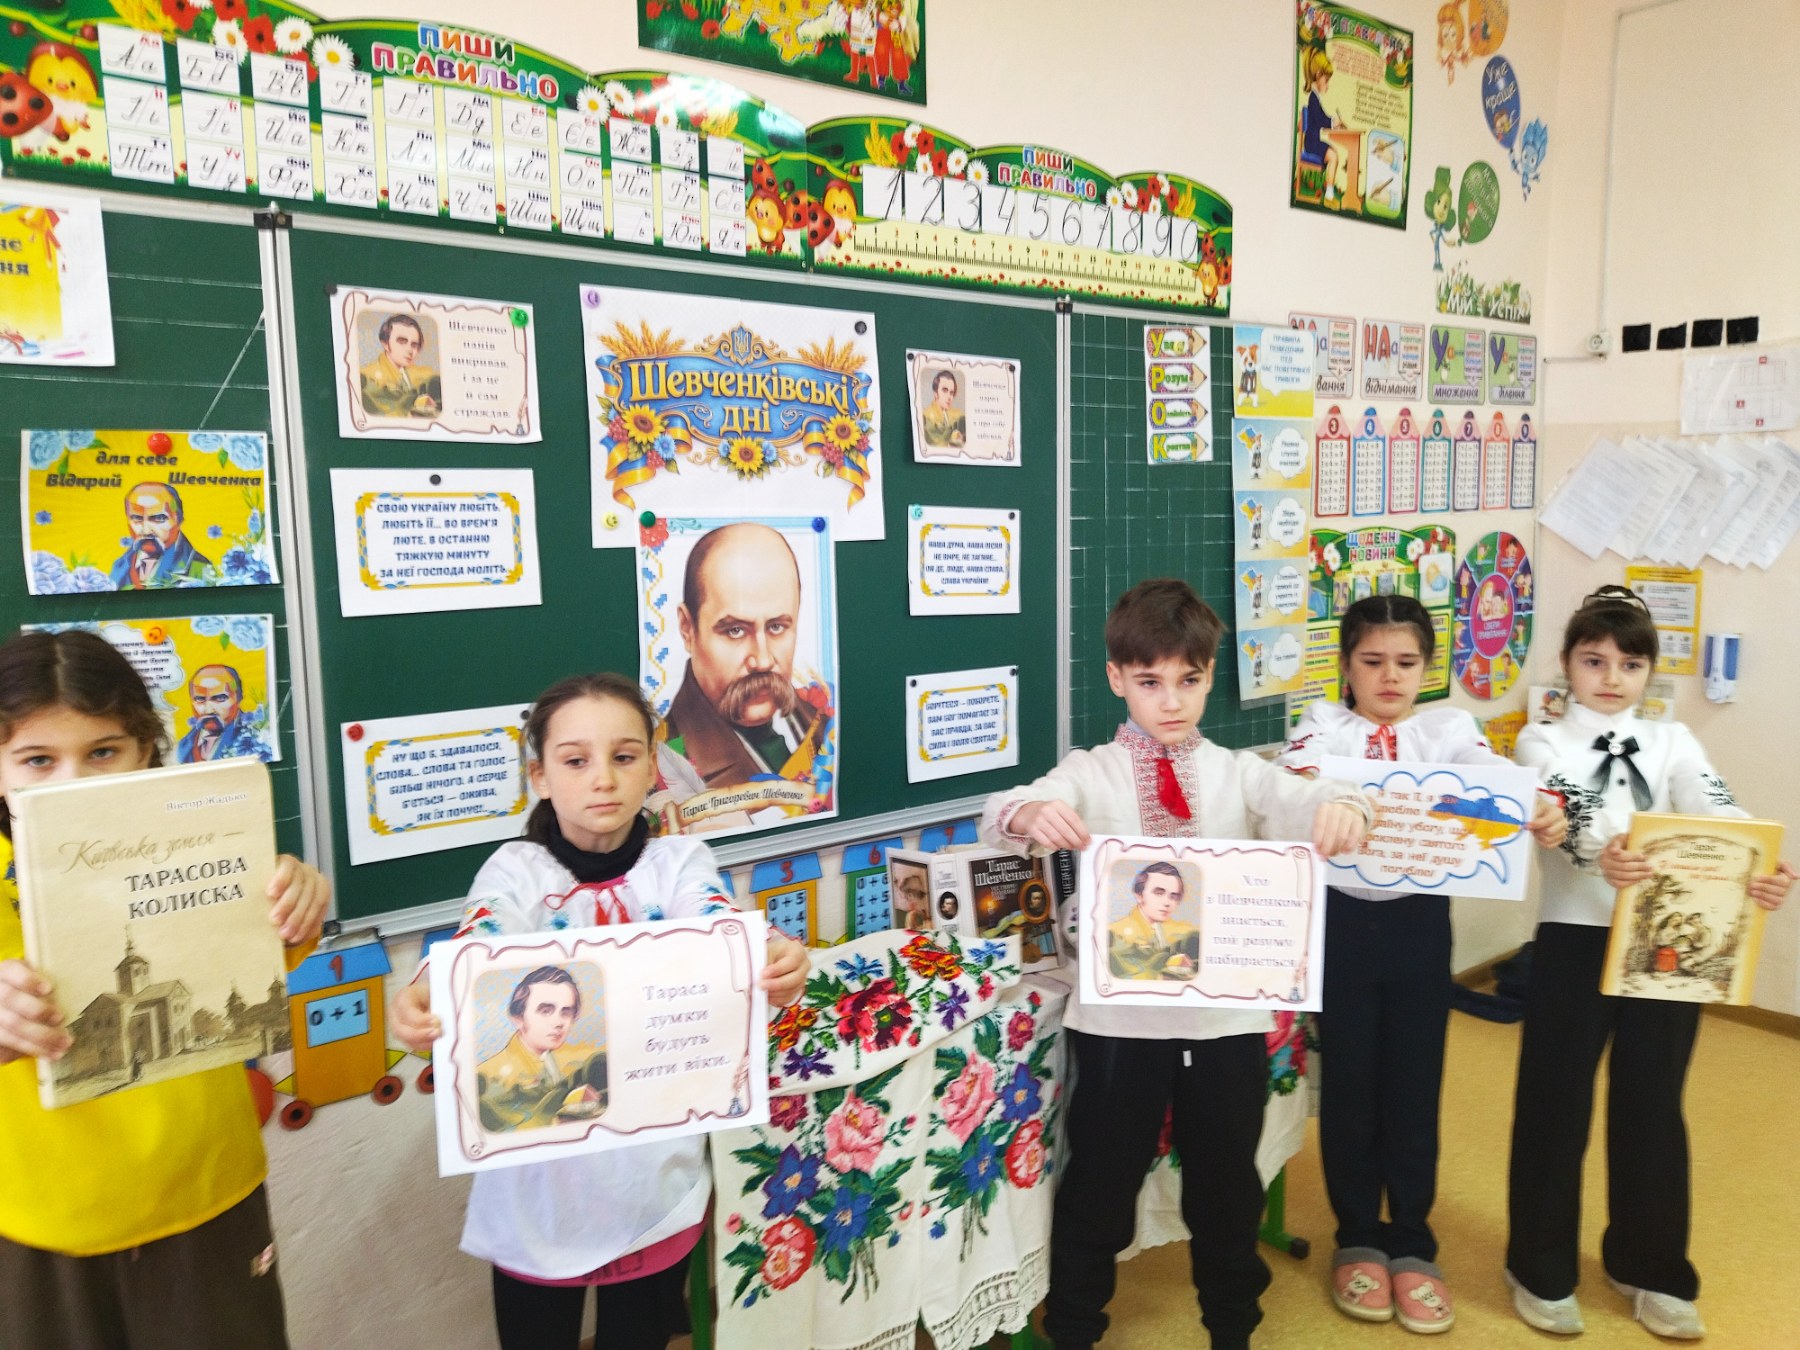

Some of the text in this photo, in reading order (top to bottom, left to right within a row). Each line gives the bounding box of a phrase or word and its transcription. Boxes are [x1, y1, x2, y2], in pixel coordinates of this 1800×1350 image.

[419, 22, 515, 65] ПИШИ
[372, 42, 559, 102] ПРАВИЛЬНО
[1485, 82, 1517, 110] краще
[1023, 145, 1074, 174] ПИШИ
[998, 162, 1097, 200] ПРАВИЛЬНО
[628, 362, 850, 414] Шевченківські
[1366, 378, 1416, 395] віднімання
[1435, 387, 1478, 398] множення
[1498, 386, 1525, 399] ділення
[720, 402, 771, 436] дні
[96, 451, 178, 465] для себе
[45, 472, 261, 491] Відкрий Шевченка
[377, 504, 408, 513] СВОЮ
[411, 501, 456, 512] УКРАЇНУ
[383, 520, 424, 529] ЛЮБІТЬ
[445, 520, 457, 528] ВО
[429, 536, 435, 544] В
[396, 550, 490, 561] ТЯЖКУЮ МИНУТУ
[1349, 547, 1396, 562] НОВИНИ
[380, 569, 393, 577] ЗА
[397, 566, 414, 577] НЕЇ
[417, 566, 464, 576] ГОСПОДА
[409, 751, 426, 761] ЩО
[422, 763, 455, 775] СЛОВА
[460, 761, 472, 771] ТА
[474, 756, 506, 769] ГОЛОС
[468, 775, 473, 783] А
[476, 771, 508, 783] СЕРЦЕ
[868, 845, 881, 865] 6
[124, 856, 248, 893] ТАРАСОВА
[780, 861, 793, 883] 5
[986, 860, 1021, 872] Тарас
[975, 870, 1033, 886] Шевченко
[128, 883, 244, 919] КОЛИСКА
[329, 955, 343, 982] 1
[642, 982, 710, 1002] Тараса
[645, 1009, 709, 1030] думки
[644, 1035, 710, 1054] будуть
[624, 1063, 678, 1082] жити
